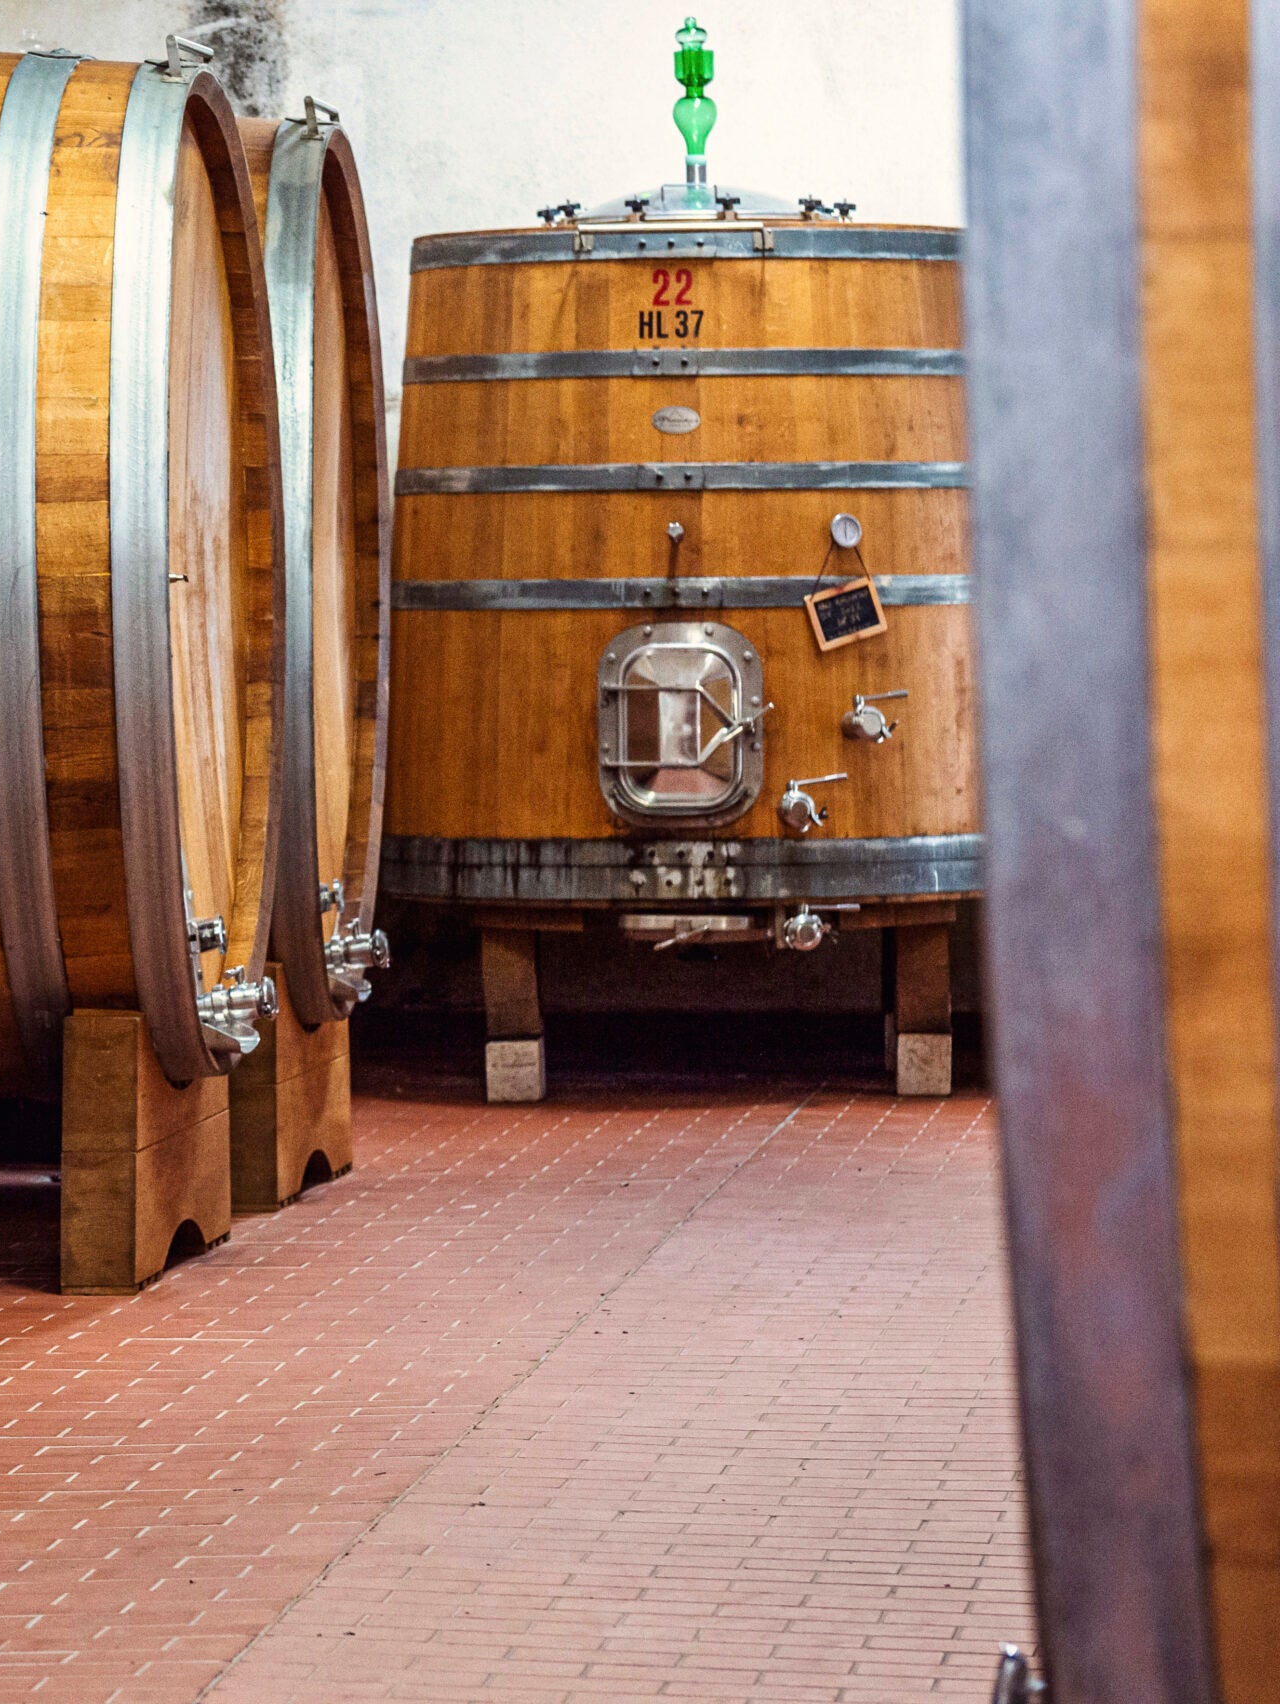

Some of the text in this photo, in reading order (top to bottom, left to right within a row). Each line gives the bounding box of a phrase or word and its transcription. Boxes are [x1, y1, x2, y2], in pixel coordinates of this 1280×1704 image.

[652, 268, 693, 306] 22
[638, 310, 704, 339] HL 37
